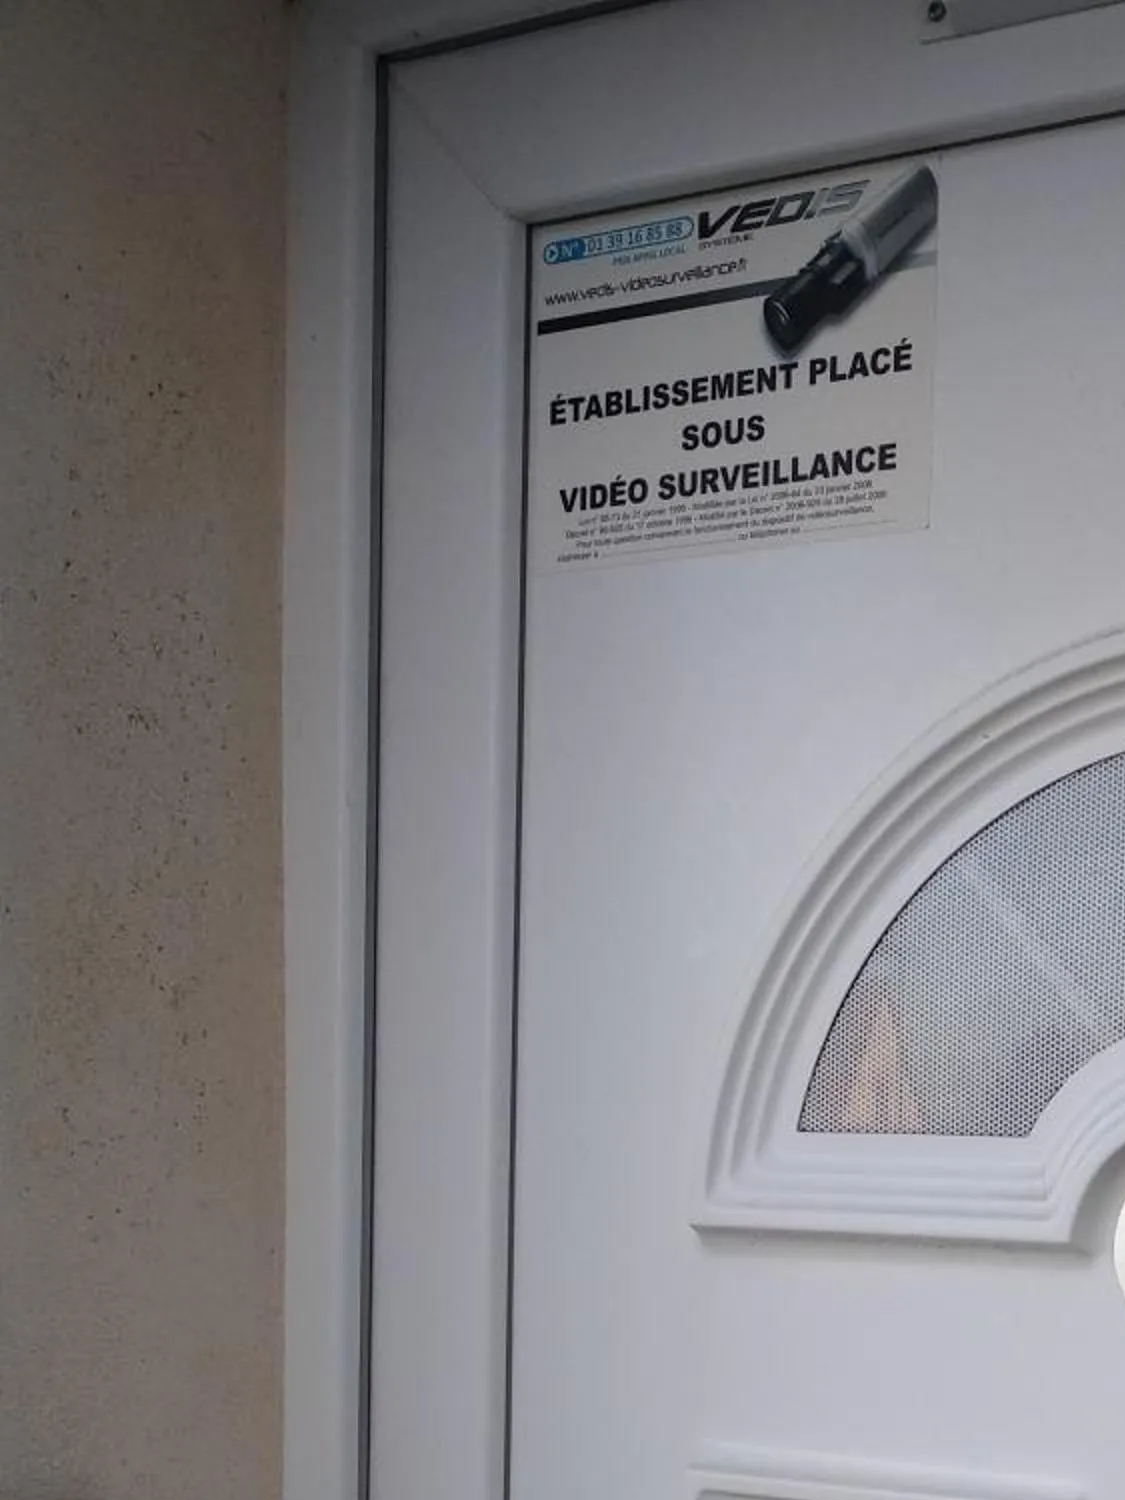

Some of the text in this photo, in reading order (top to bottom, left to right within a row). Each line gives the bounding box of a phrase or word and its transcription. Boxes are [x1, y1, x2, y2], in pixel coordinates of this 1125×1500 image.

[587, 238, 602, 253] 01
[607, 233, 623, 249] 39
[628, 229, 641, 245] 16
[646, 225, 663, 241] 85
[549, 338, 913, 426] ÉTABLISSEMENT PLACÉ
[681, 415, 766, 451] SOUS
[558, 474, 649, 513] VIDÉO
[657, 443, 898, 501] SURVEILLANCE
